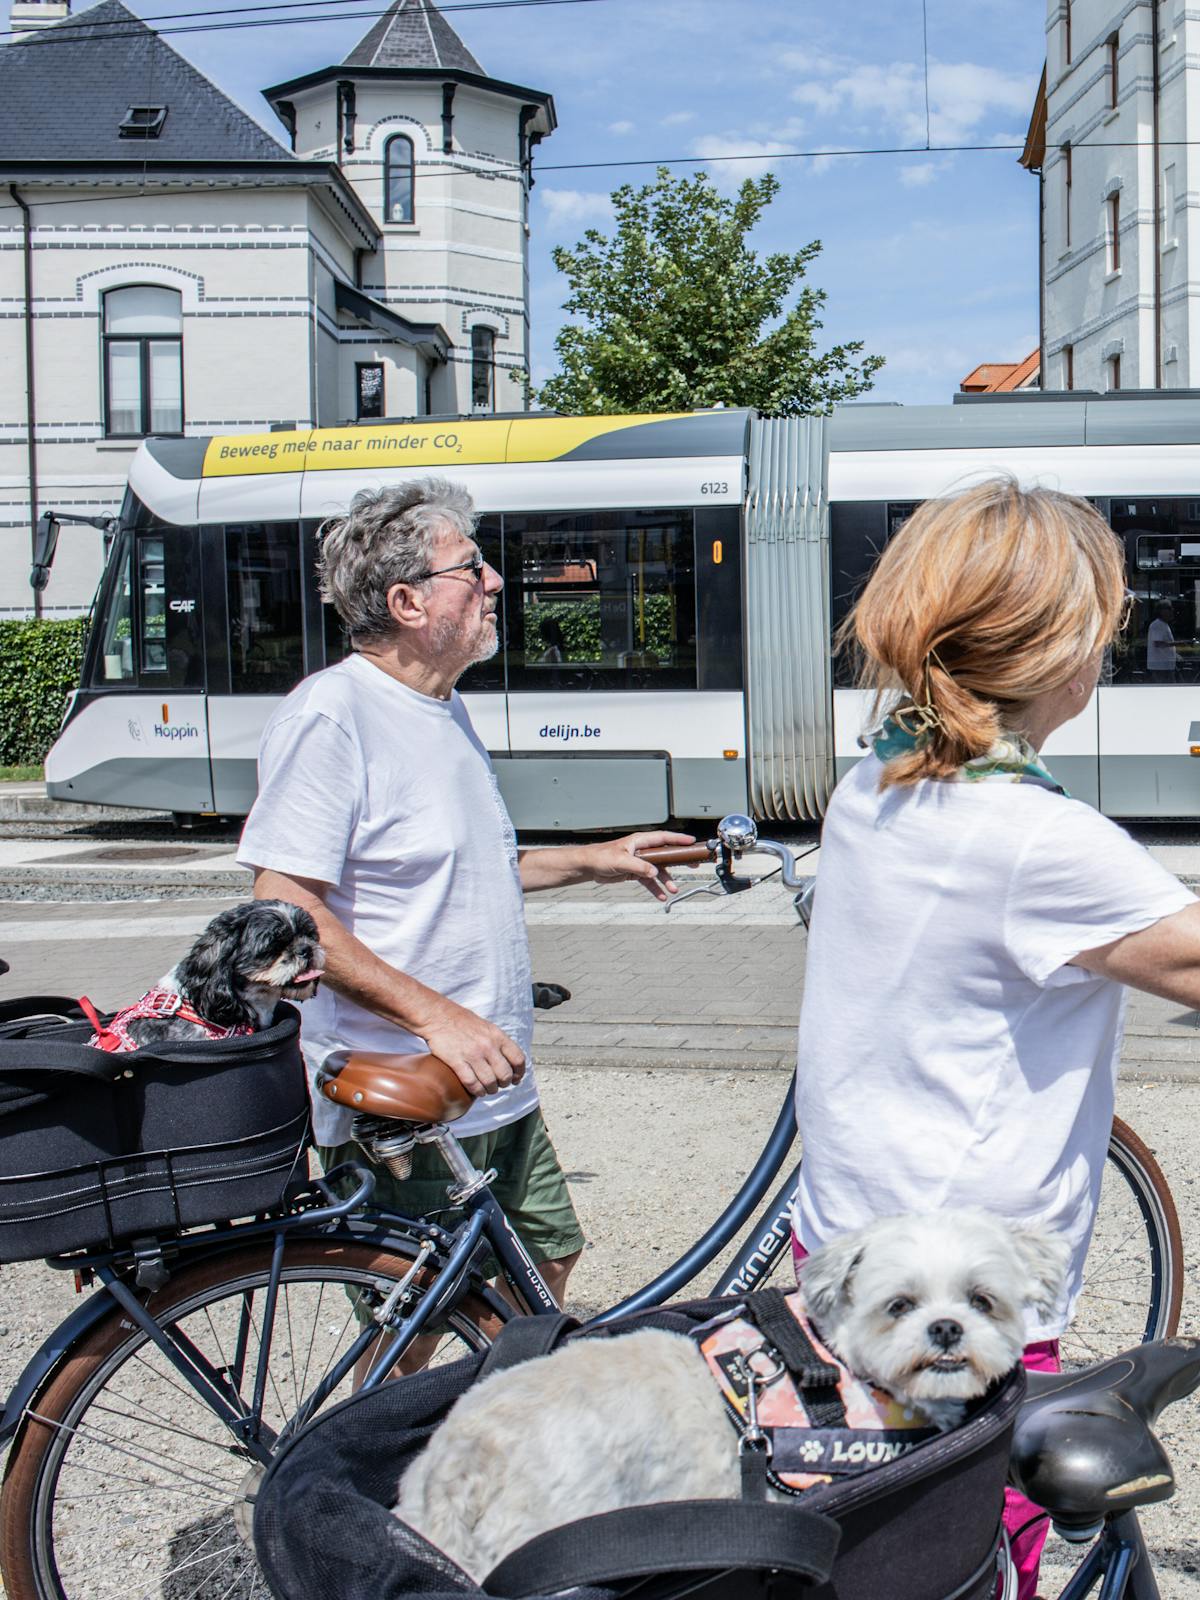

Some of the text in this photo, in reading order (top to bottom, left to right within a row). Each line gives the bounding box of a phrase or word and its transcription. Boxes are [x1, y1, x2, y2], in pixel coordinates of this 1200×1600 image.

[219, 443, 279, 459] Beweeg
[282, 440, 317, 454] mee
[322, 438, 362, 451] naar
[366, 435, 428, 449] minder
[701, 482, 728, 494] 6123
[169, 600, 196, 613] CAF
[154, 722, 198, 740] Hoppin
[539, 725, 601, 741] delijn.be
[721, 1186, 800, 1297] minerv
[526, 1268, 552, 1308] LUXOR
[831, 1440, 915, 1464] LOUN
